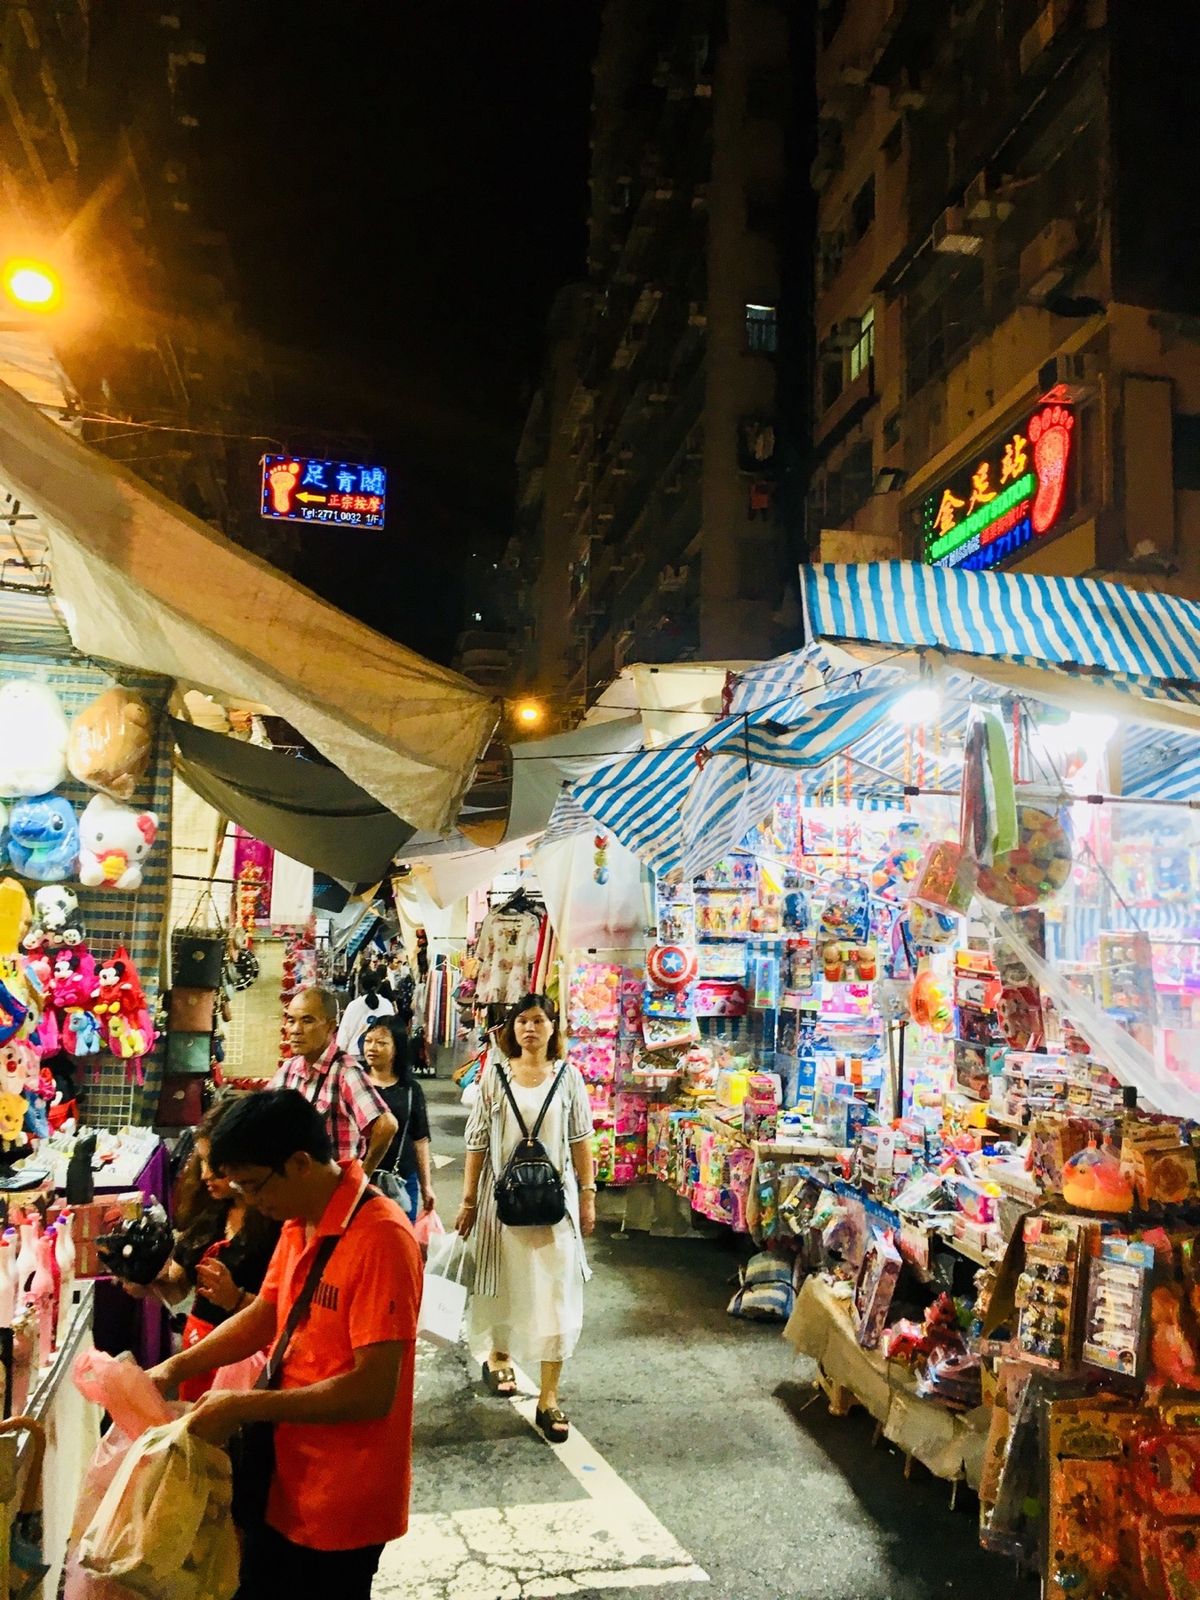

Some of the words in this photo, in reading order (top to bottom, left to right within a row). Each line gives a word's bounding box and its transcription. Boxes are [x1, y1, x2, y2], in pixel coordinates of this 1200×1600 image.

[327, 494, 380, 513] 正宗按摩
[991, 473, 1032, 519] STATION
[366, 514, 380, 524] 1/F
